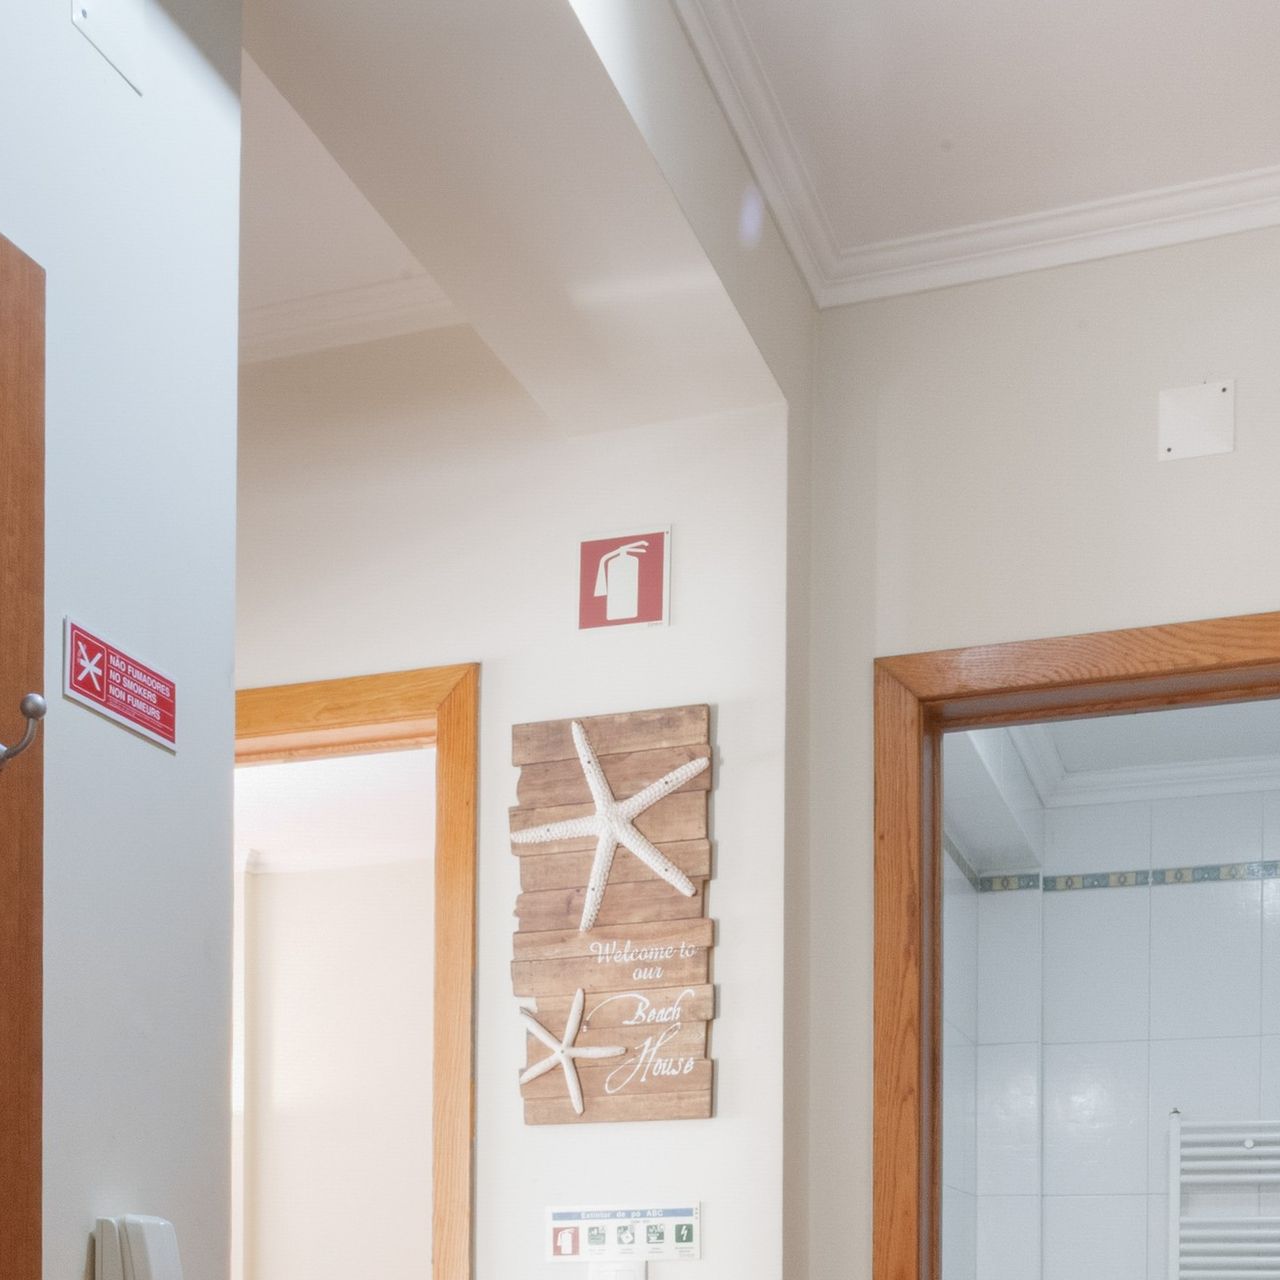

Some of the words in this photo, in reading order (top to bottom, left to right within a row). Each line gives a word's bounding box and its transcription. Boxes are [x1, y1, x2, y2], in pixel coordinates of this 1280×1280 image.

[109, 670, 121, 683] NO
[122, 677, 157, 704] SMOKERS
[127, 664, 170, 697] FUMADORES
[109, 684, 126, 702] NON
[127, 694, 161, 720] FUMEURS
[589, 940, 675, 964] Welcome
[679, 943, 699, 959] to
[632, 966, 663, 981] our
[586, 989, 695, 1030] Beach
[605, 1023, 694, 1093] House
